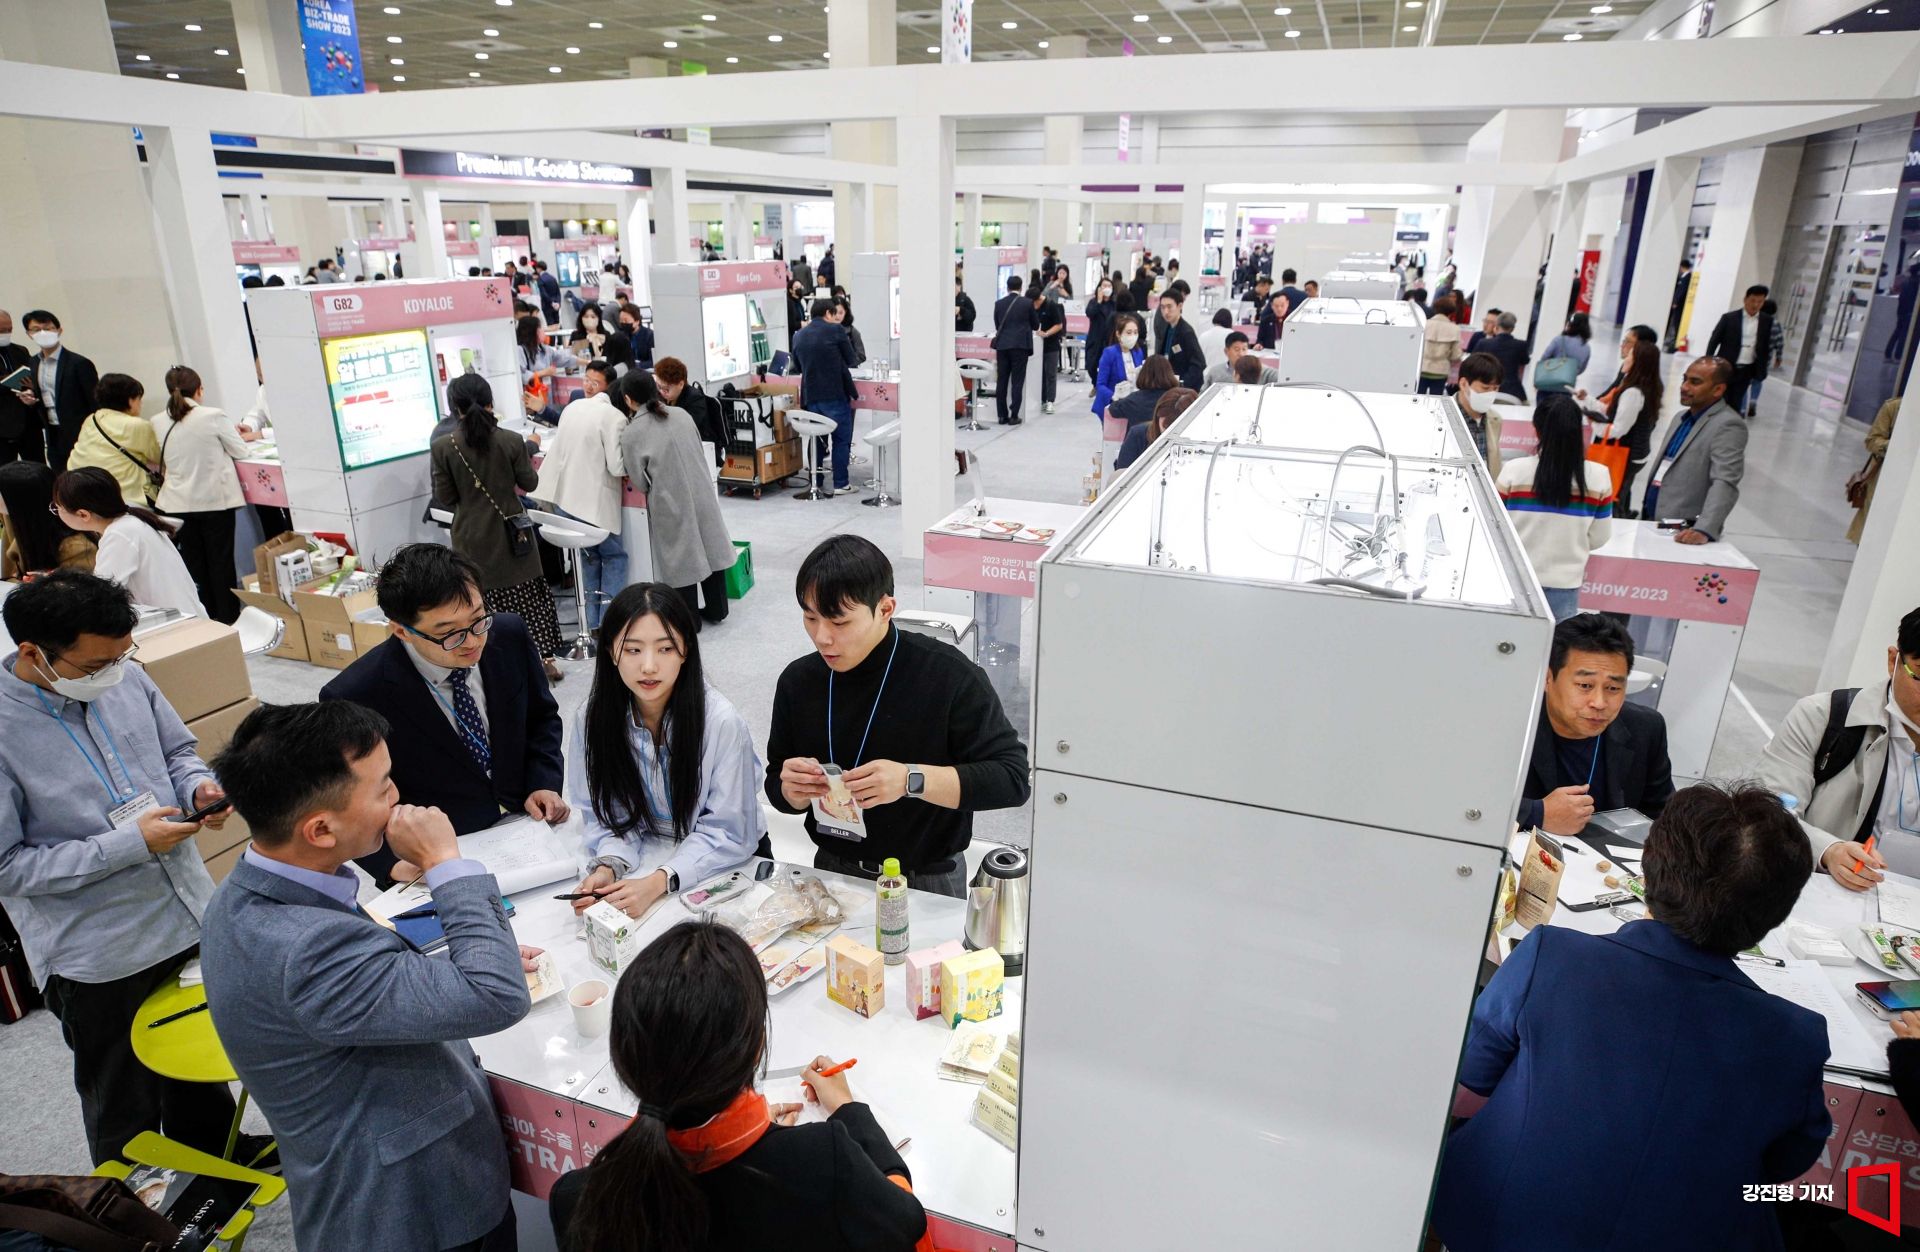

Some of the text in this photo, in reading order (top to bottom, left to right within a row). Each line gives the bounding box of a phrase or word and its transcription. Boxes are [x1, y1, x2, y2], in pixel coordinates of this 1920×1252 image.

[304, 7, 350, 26] BIZ-TRADE
[306, 18, 352, 36] SHOW 2023
[456, 151, 635, 183] Premium K-Goods Showcase
[333, 298, 354, 311] G82
[982, 555, 1001, 565] 2023
[1001, 557, 1025, 568] 상반기
[982, 564, 1037, 583] KOREA B
[1581, 582, 1669, 602] SHOW 2023
[830, 827, 849, 837] SELLER
[502, 1114, 603, 1160] 리아 수출 상
[1852, 1129, 1920, 1159] 상담회
[513, 1138, 578, 1175] -TRA
[1903, 1165, 1920, 1190] S
[191, 1199, 215, 1223] CAKE
